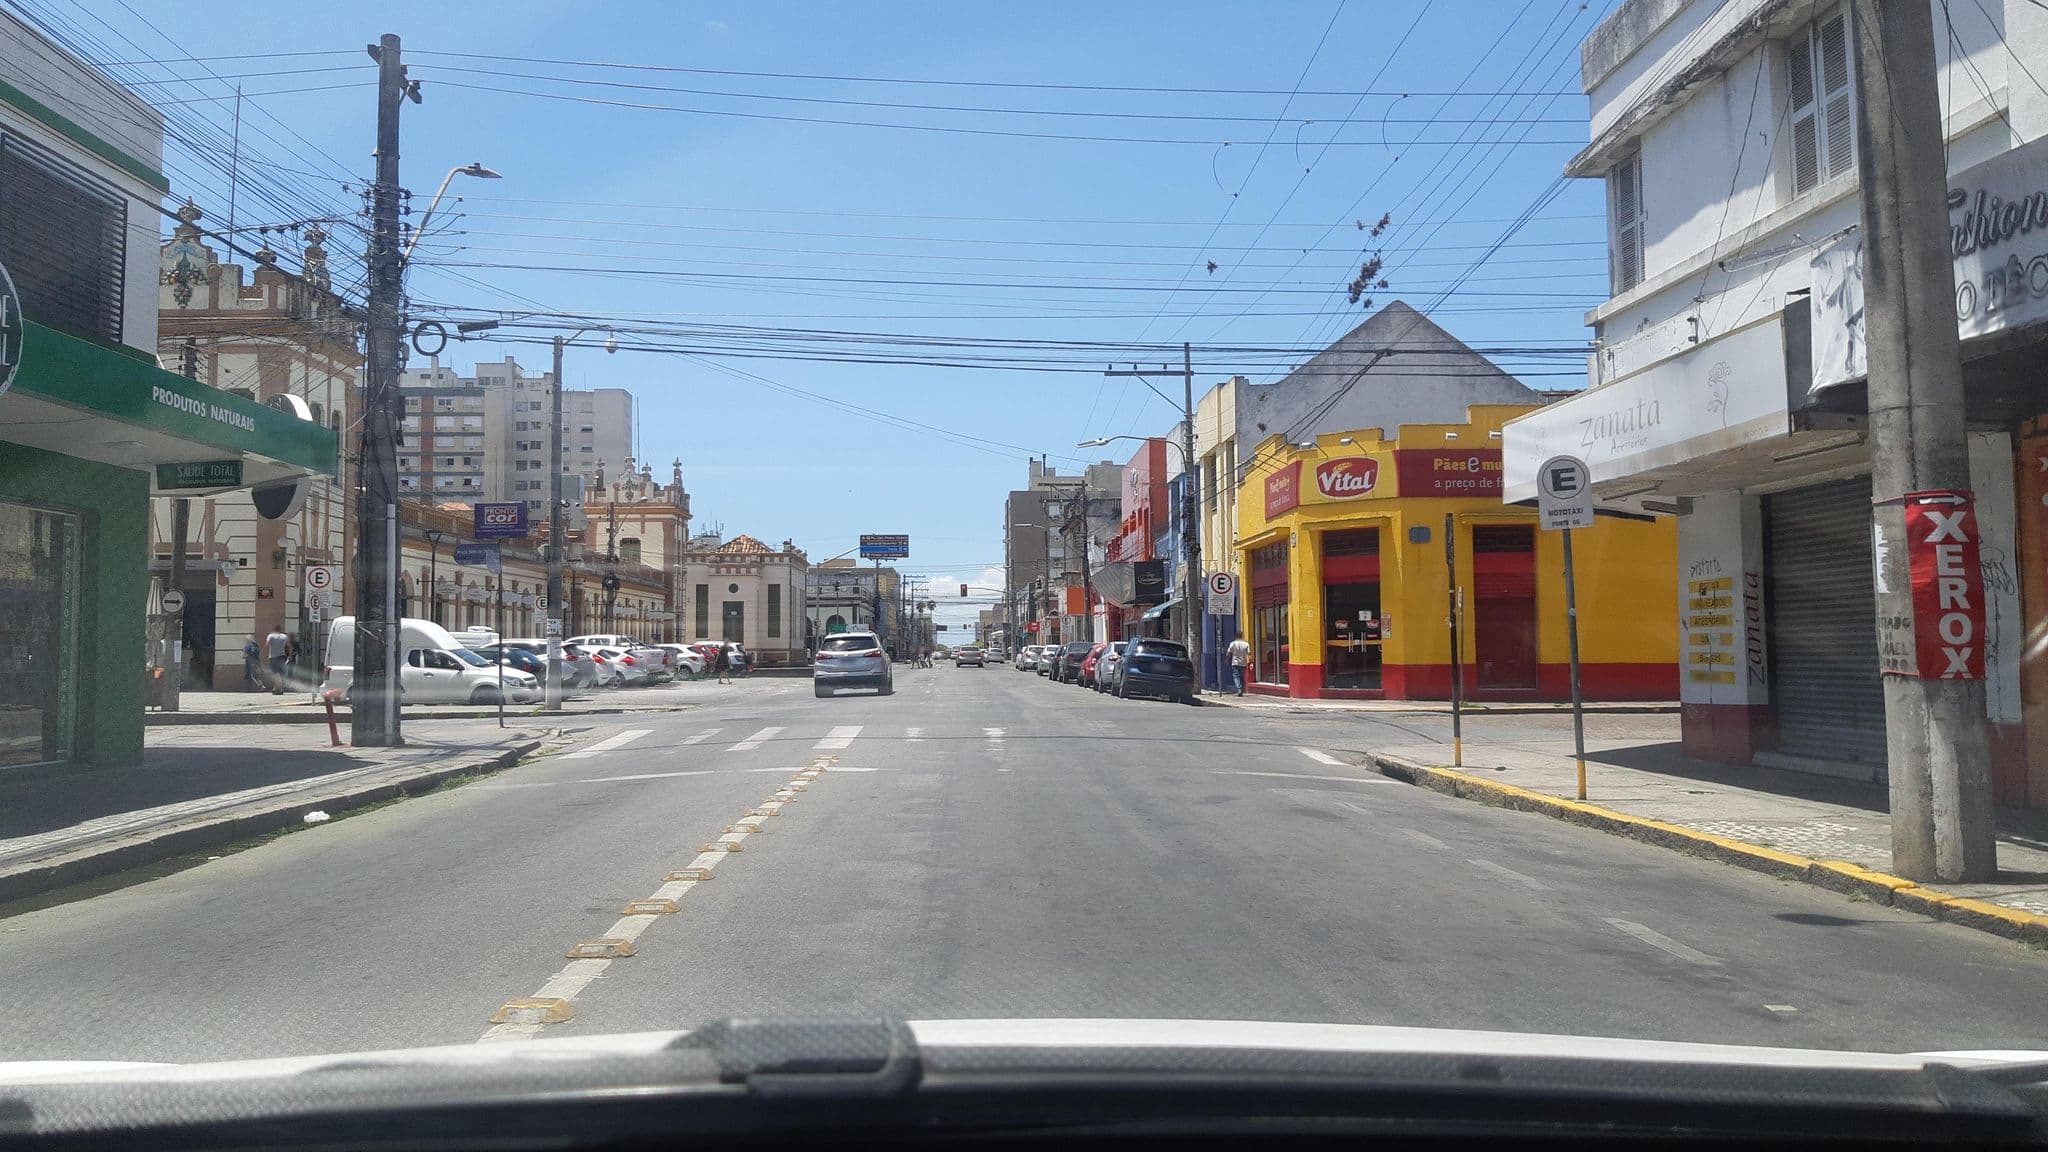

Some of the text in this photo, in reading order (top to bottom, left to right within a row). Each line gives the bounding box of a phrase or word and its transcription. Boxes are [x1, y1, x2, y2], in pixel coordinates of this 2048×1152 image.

[152, 385, 255, 431] PRODUTOS NATURAIS
[1433, 458, 1466, 471] Pães
[1467, 457, 1480, 473] e
[1318, 470, 1373, 492] Vital
[1434, 480, 1441, 488] a
[1445, 479, 1476, 491] preço
[1479, 477, 1493, 488] de
[1550, 467, 1577, 492] E
[486, 514, 517, 523] cor
[315, 571, 324, 585] E
[1217, 577, 1227, 590] E
[1923, 510, 1974, 679] XEROX
